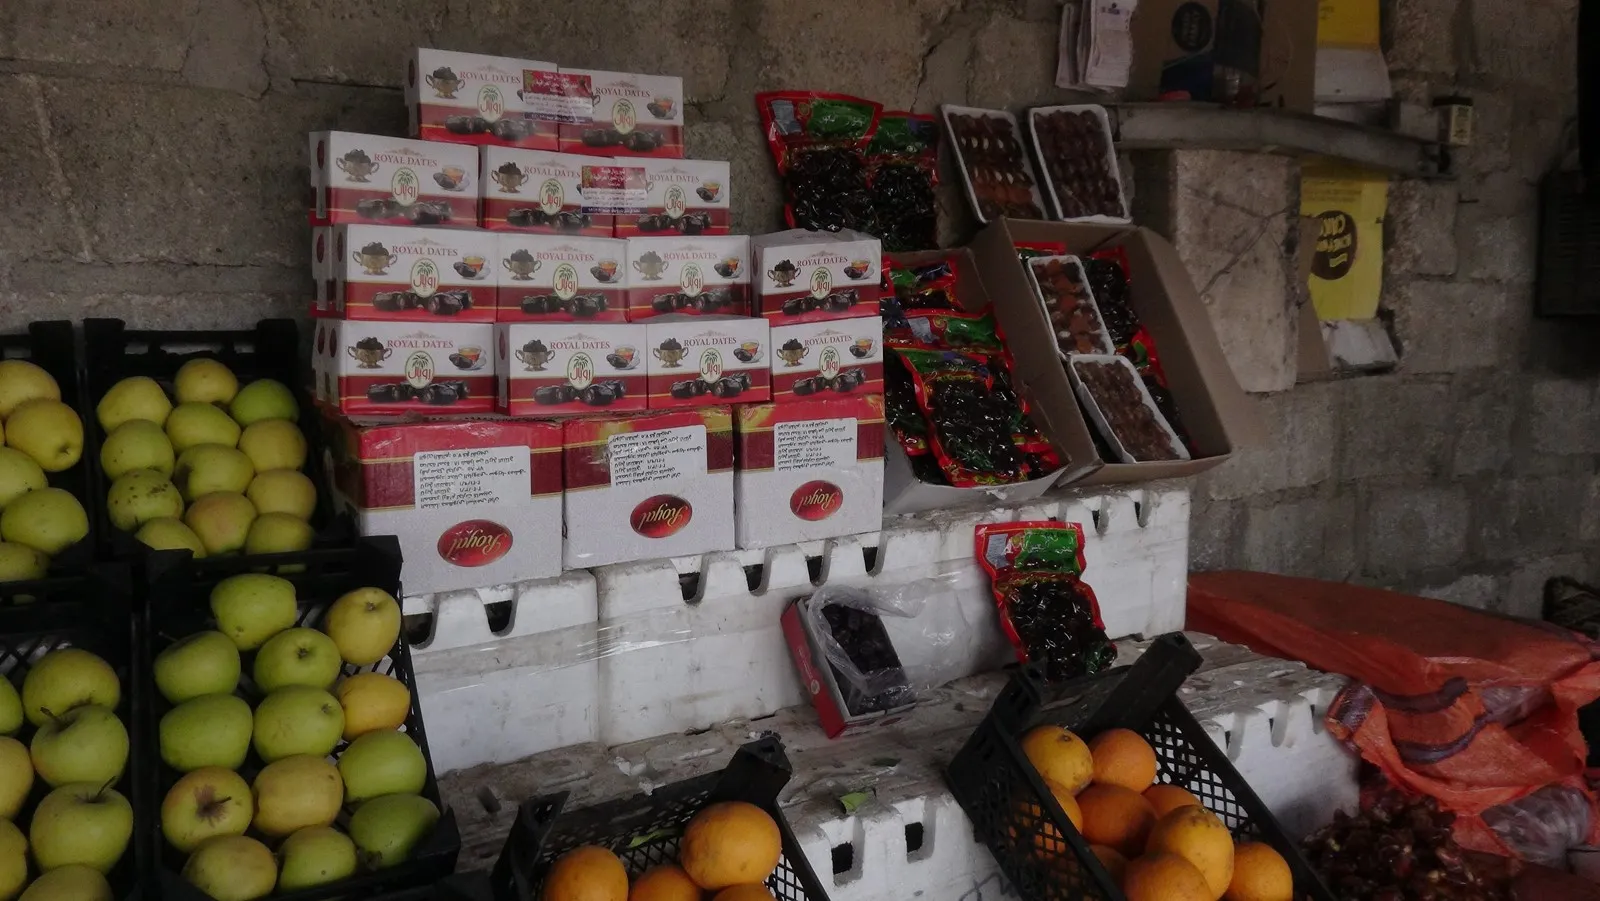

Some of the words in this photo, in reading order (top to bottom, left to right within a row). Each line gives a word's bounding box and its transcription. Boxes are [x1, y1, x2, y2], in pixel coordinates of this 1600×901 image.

[460, 71, 490, 82] ROYAL
[493, 73, 520, 84] DATES
[596, 87, 623, 96] ROYAL
[625, 88, 651, 98] DATES
[374, 153, 404, 164] ROYAL
[407, 158, 438, 167] DATES
[524, 166, 553, 176] ROYAL
[555, 168, 581, 178] DATES
[674, 175, 700, 183] DATES
[392, 245, 424, 256] ROYAL
[427, 246, 458, 257] DATES
[536, 252, 565, 261] ROYAL
[567, 253, 594, 262] DATES
[797, 259, 822, 267] ROYAL
[823, 257, 848, 265] DATES
[387, 339, 419, 348] ROYAL
[422, 339, 454, 348] DATES
[550, 341, 579, 350] ROYAL
[581, 341, 610, 349] DATES
[684, 338, 710, 346] ROYAL
[712, 337, 737, 345] DATES
[797, 488, 840, 512] Royal
[639, 503, 688, 529] Royal
[448, 530, 507, 556] Royal
